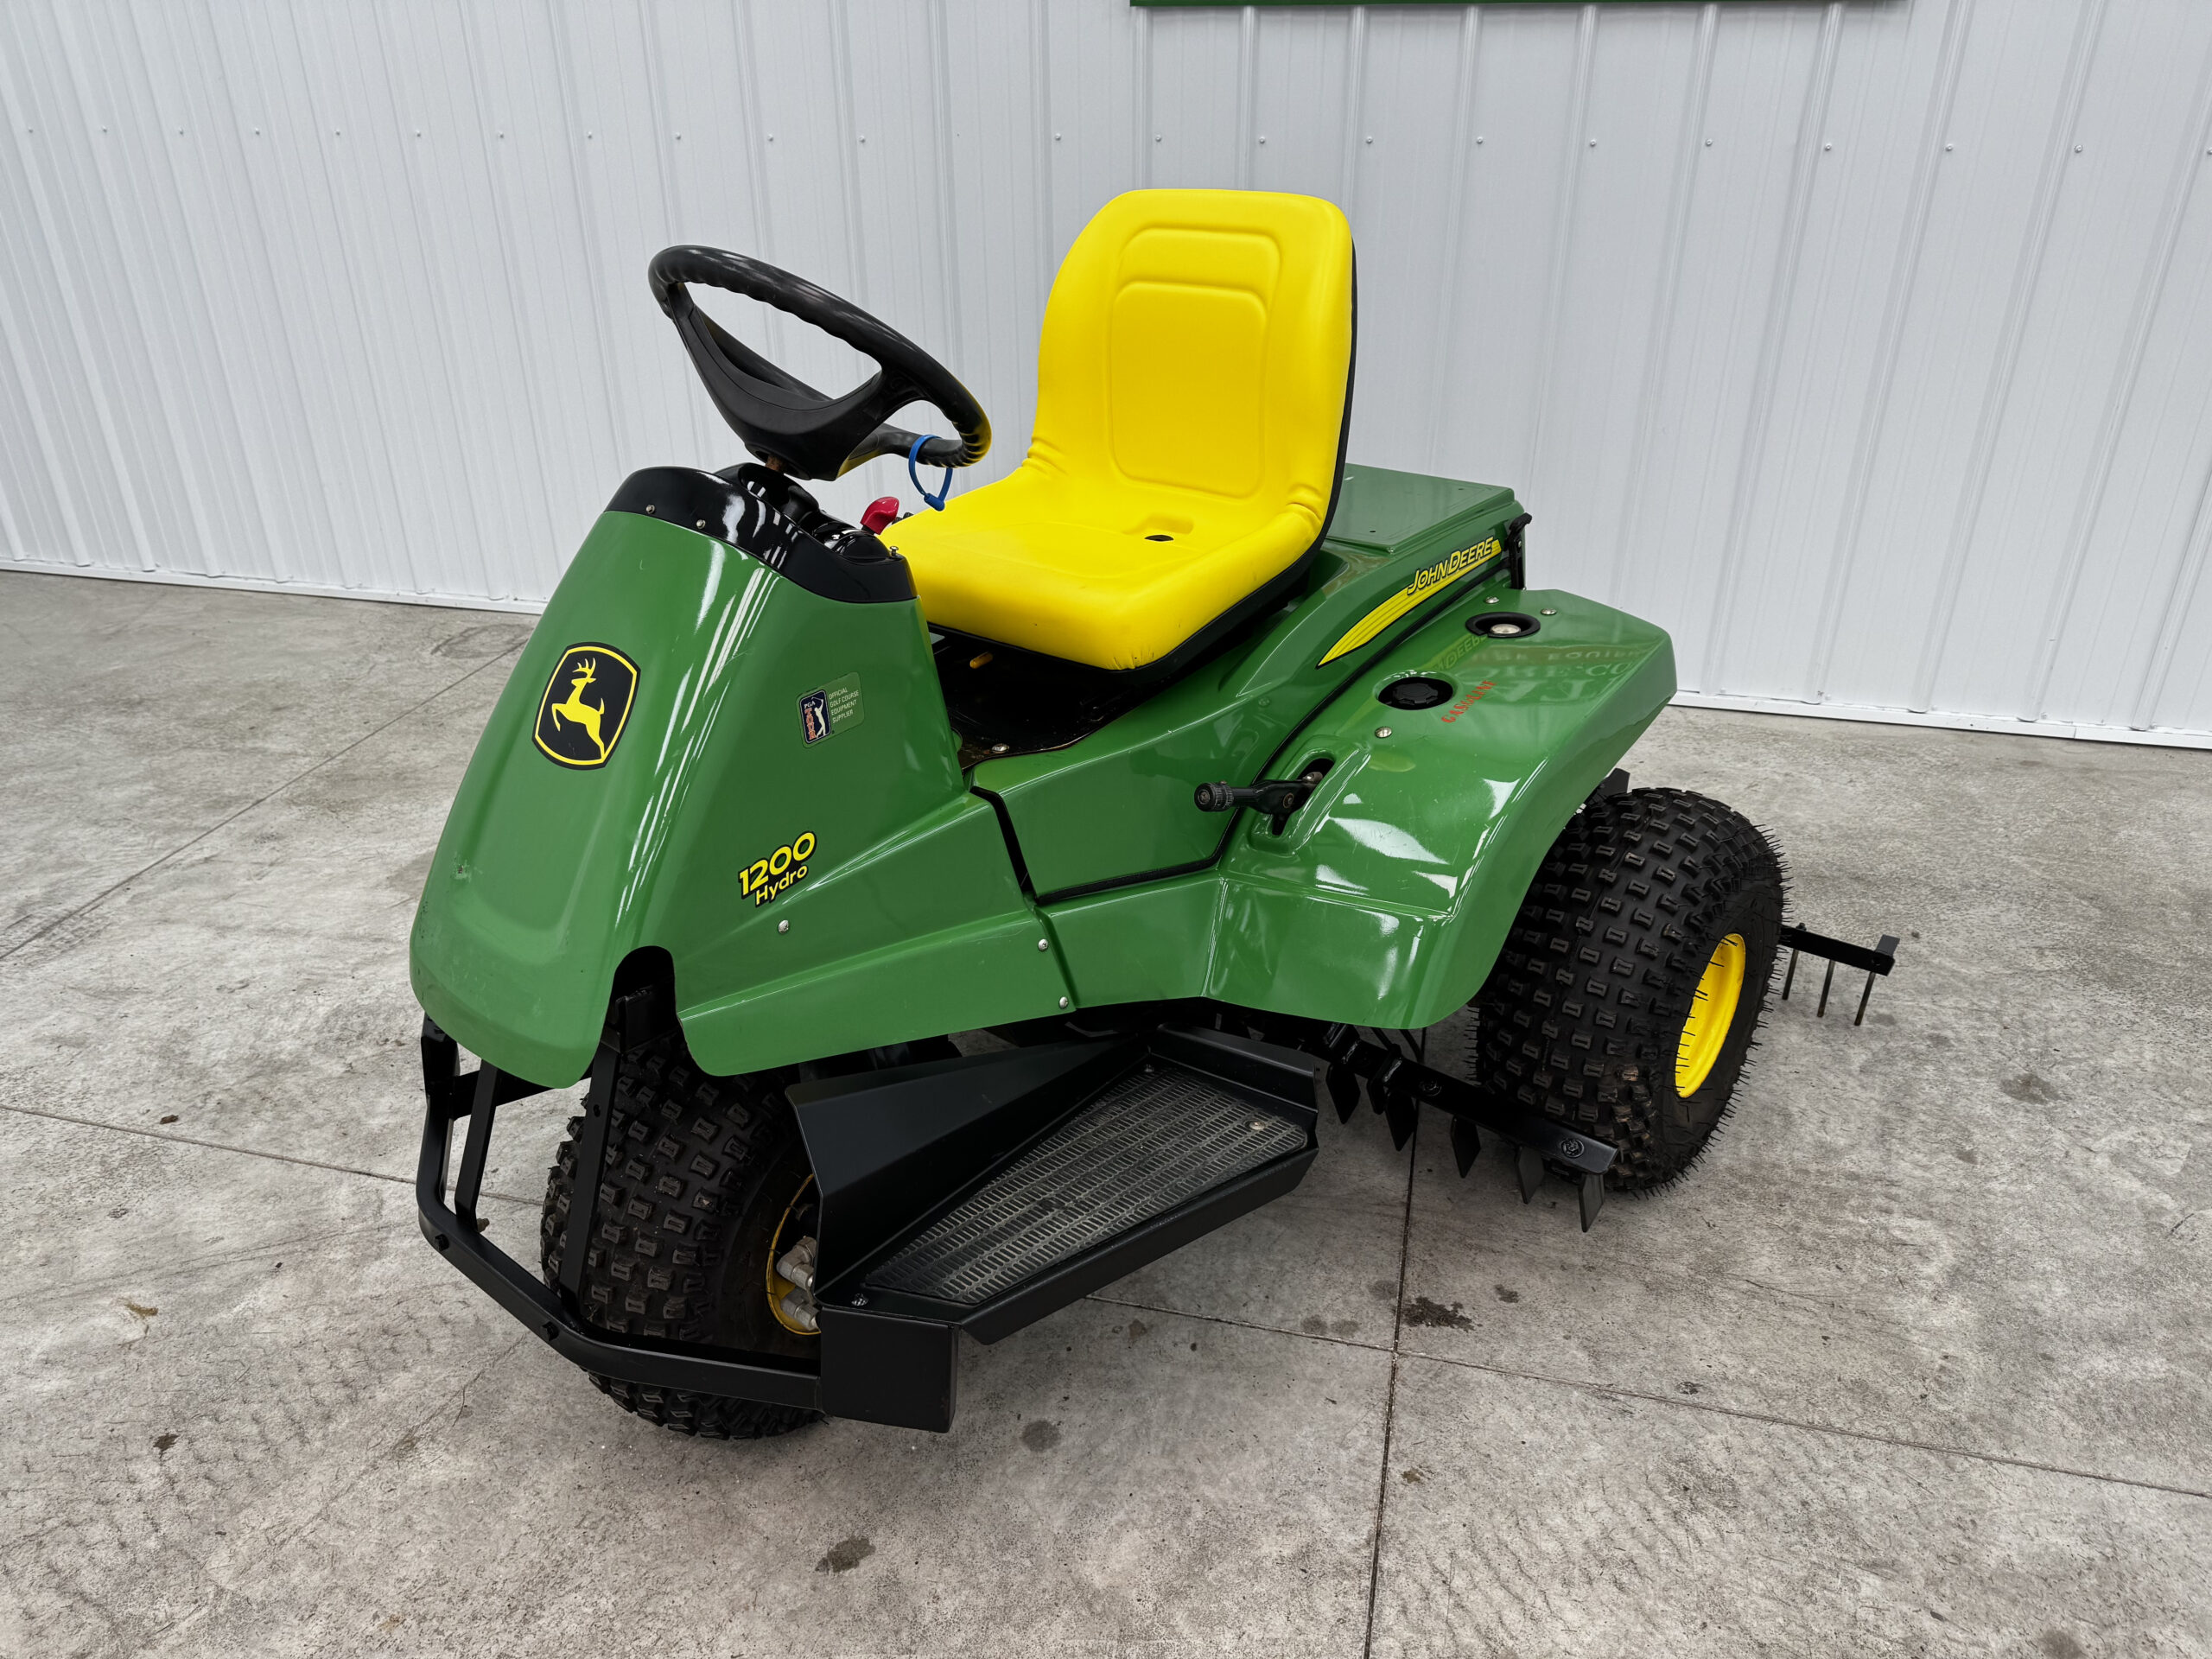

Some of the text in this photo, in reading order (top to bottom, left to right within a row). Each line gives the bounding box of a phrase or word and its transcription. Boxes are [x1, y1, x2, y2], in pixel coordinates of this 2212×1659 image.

[1407, 537, 1494, 595] JOHN DEERE
[829, 688, 848, 700] OFFICIAL
[830, 690, 859, 708] GOLF COURSE
[830, 700, 857, 715] EQUIPMENT
[832, 709, 854, 723] SUPPLIER
[804, 708, 817, 740] TOUR
[739, 831, 817, 897] 1200
[756, 865, 808, 906] Hydro
